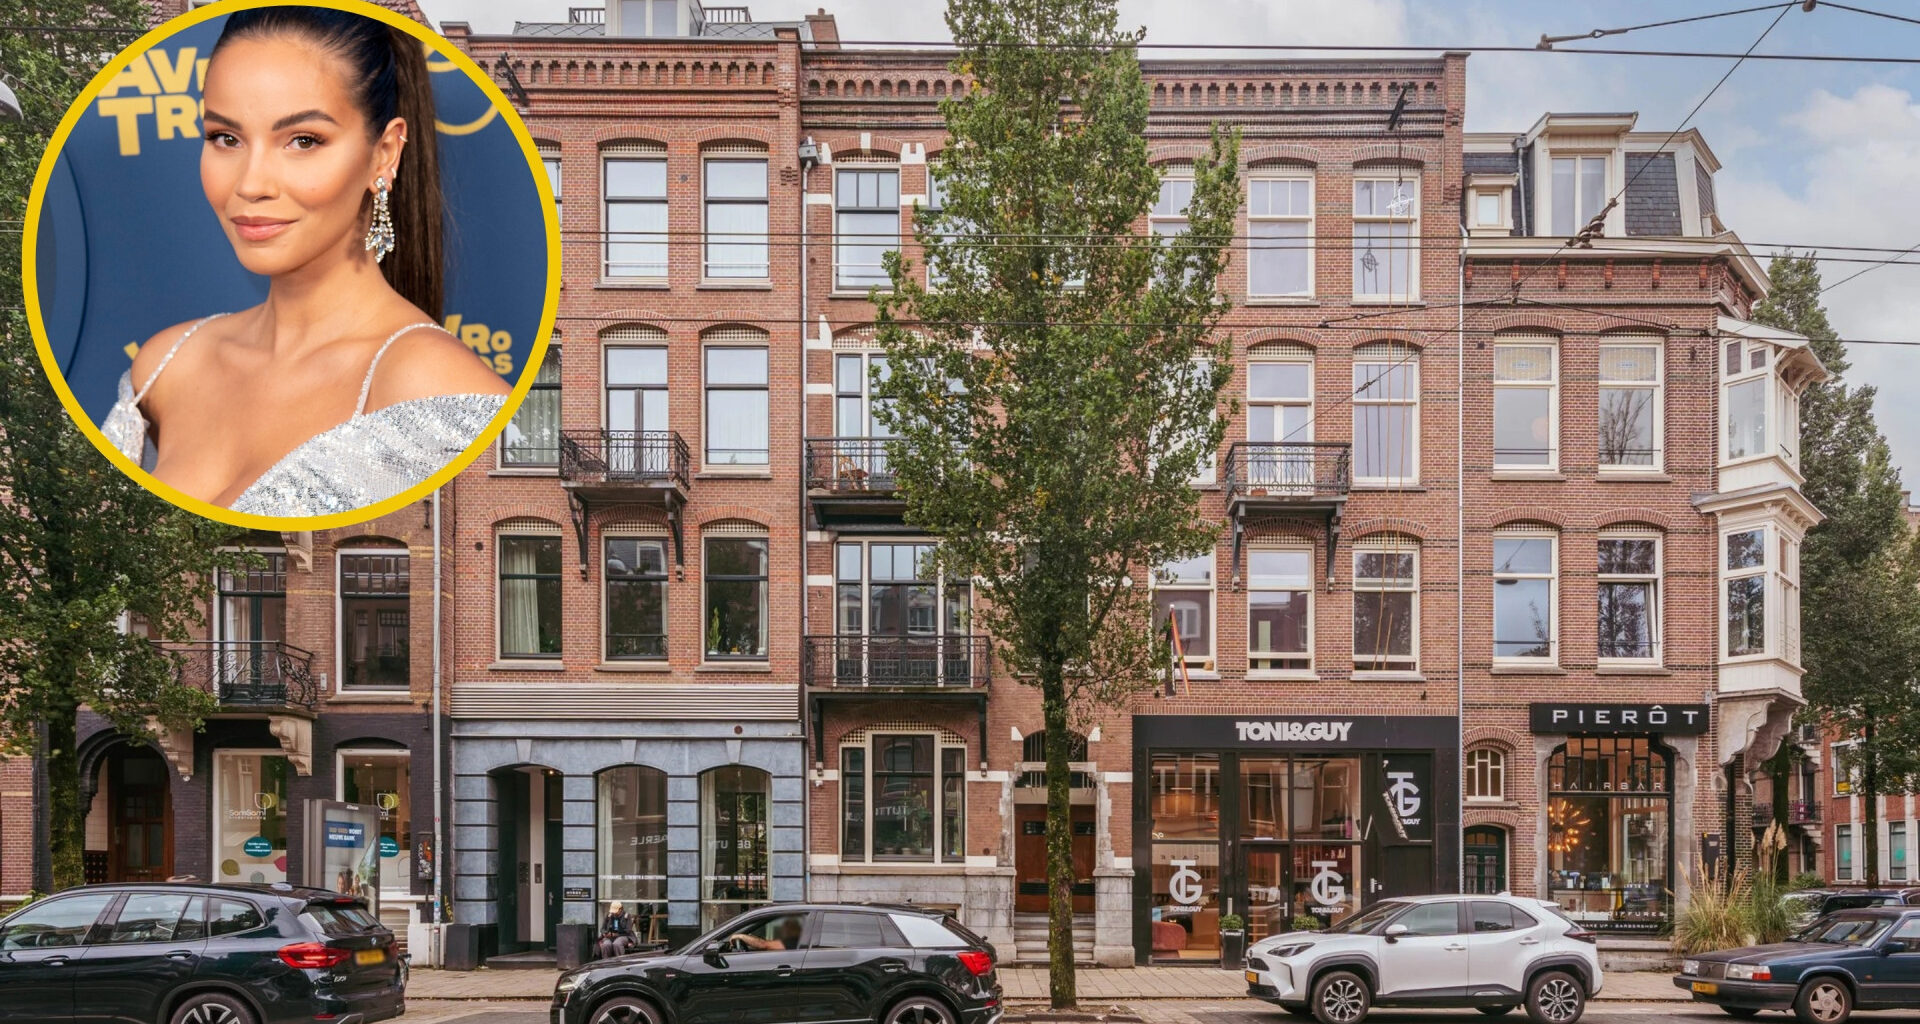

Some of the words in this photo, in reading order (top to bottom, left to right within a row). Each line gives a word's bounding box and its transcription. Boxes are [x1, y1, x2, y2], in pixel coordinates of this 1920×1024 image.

[98, 95, 204, 156] TR
[1553, 705, 1698, 724] PIERÔT
[1236, 722, 1353, 741] TONI&GUY
[1554, 782, 1662, 790] HAIRBAR
